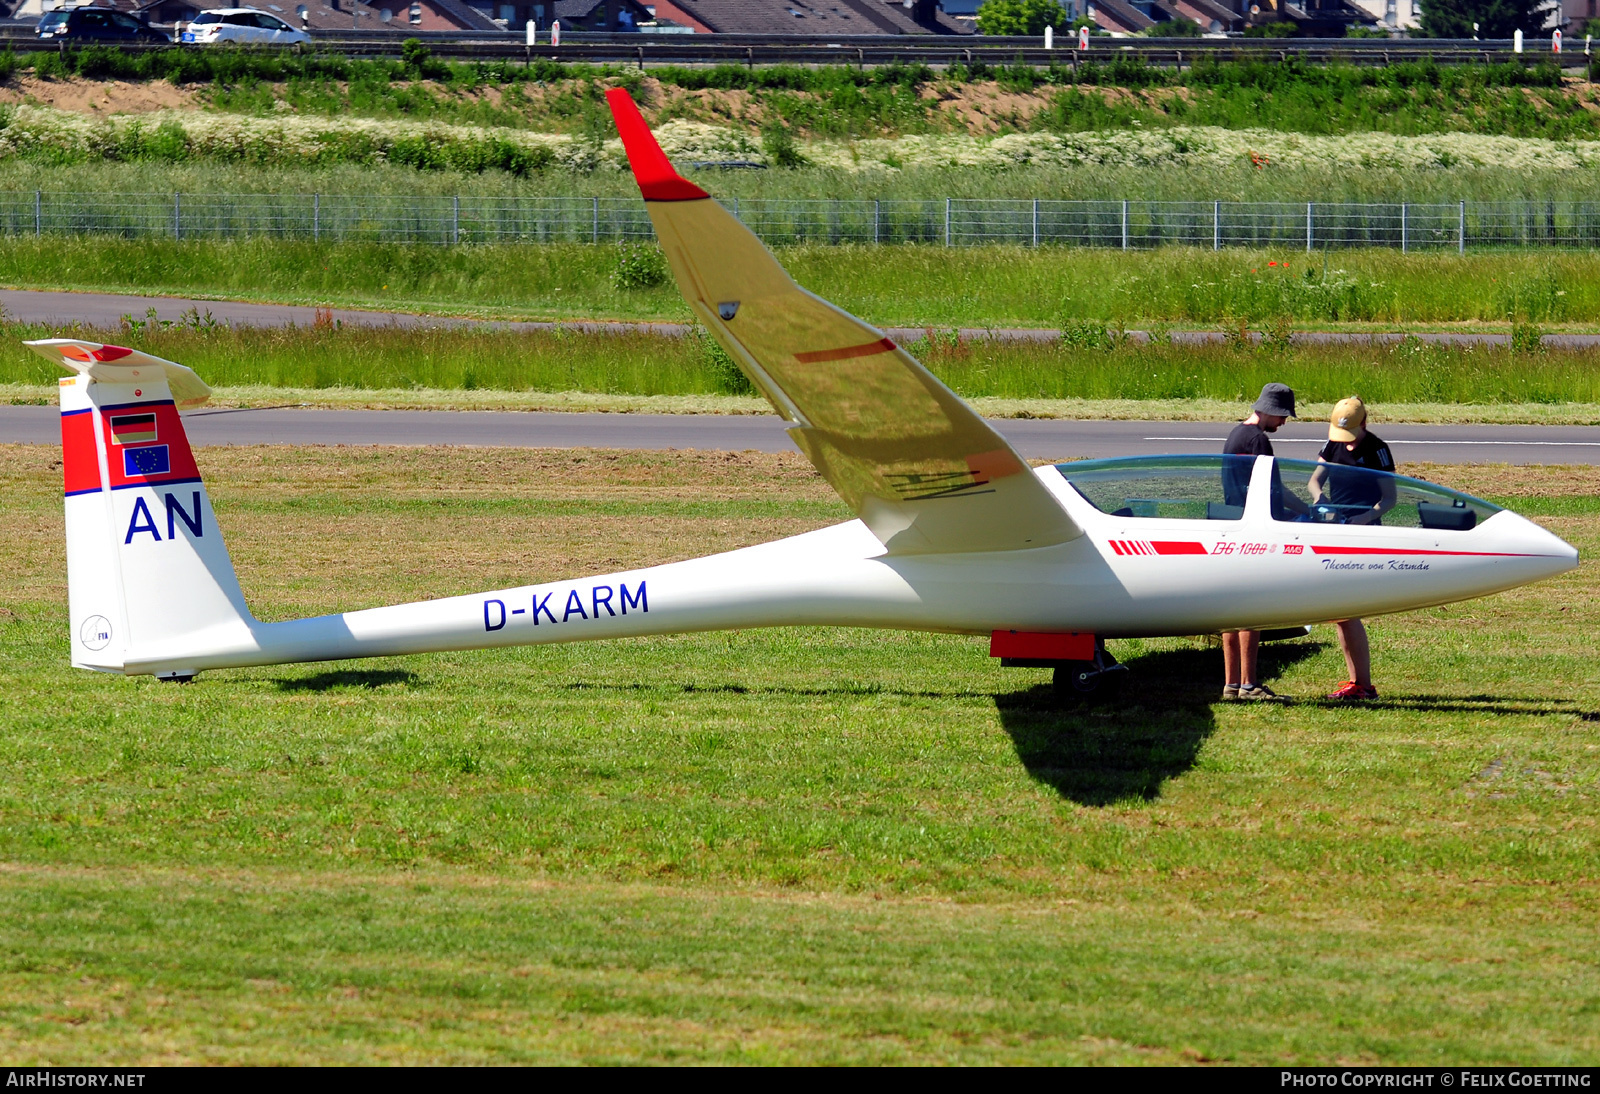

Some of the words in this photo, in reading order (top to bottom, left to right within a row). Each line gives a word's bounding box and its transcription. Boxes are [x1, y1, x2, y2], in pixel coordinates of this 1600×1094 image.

[124, 491, 203, 545] AN
[1284, 545, 1303, 554] AMS
[1322, 558, 1364, 570] Theodore
[1388, 559, 1430, 571] Kármán
[483, 580, 649, 632] D-KARM
